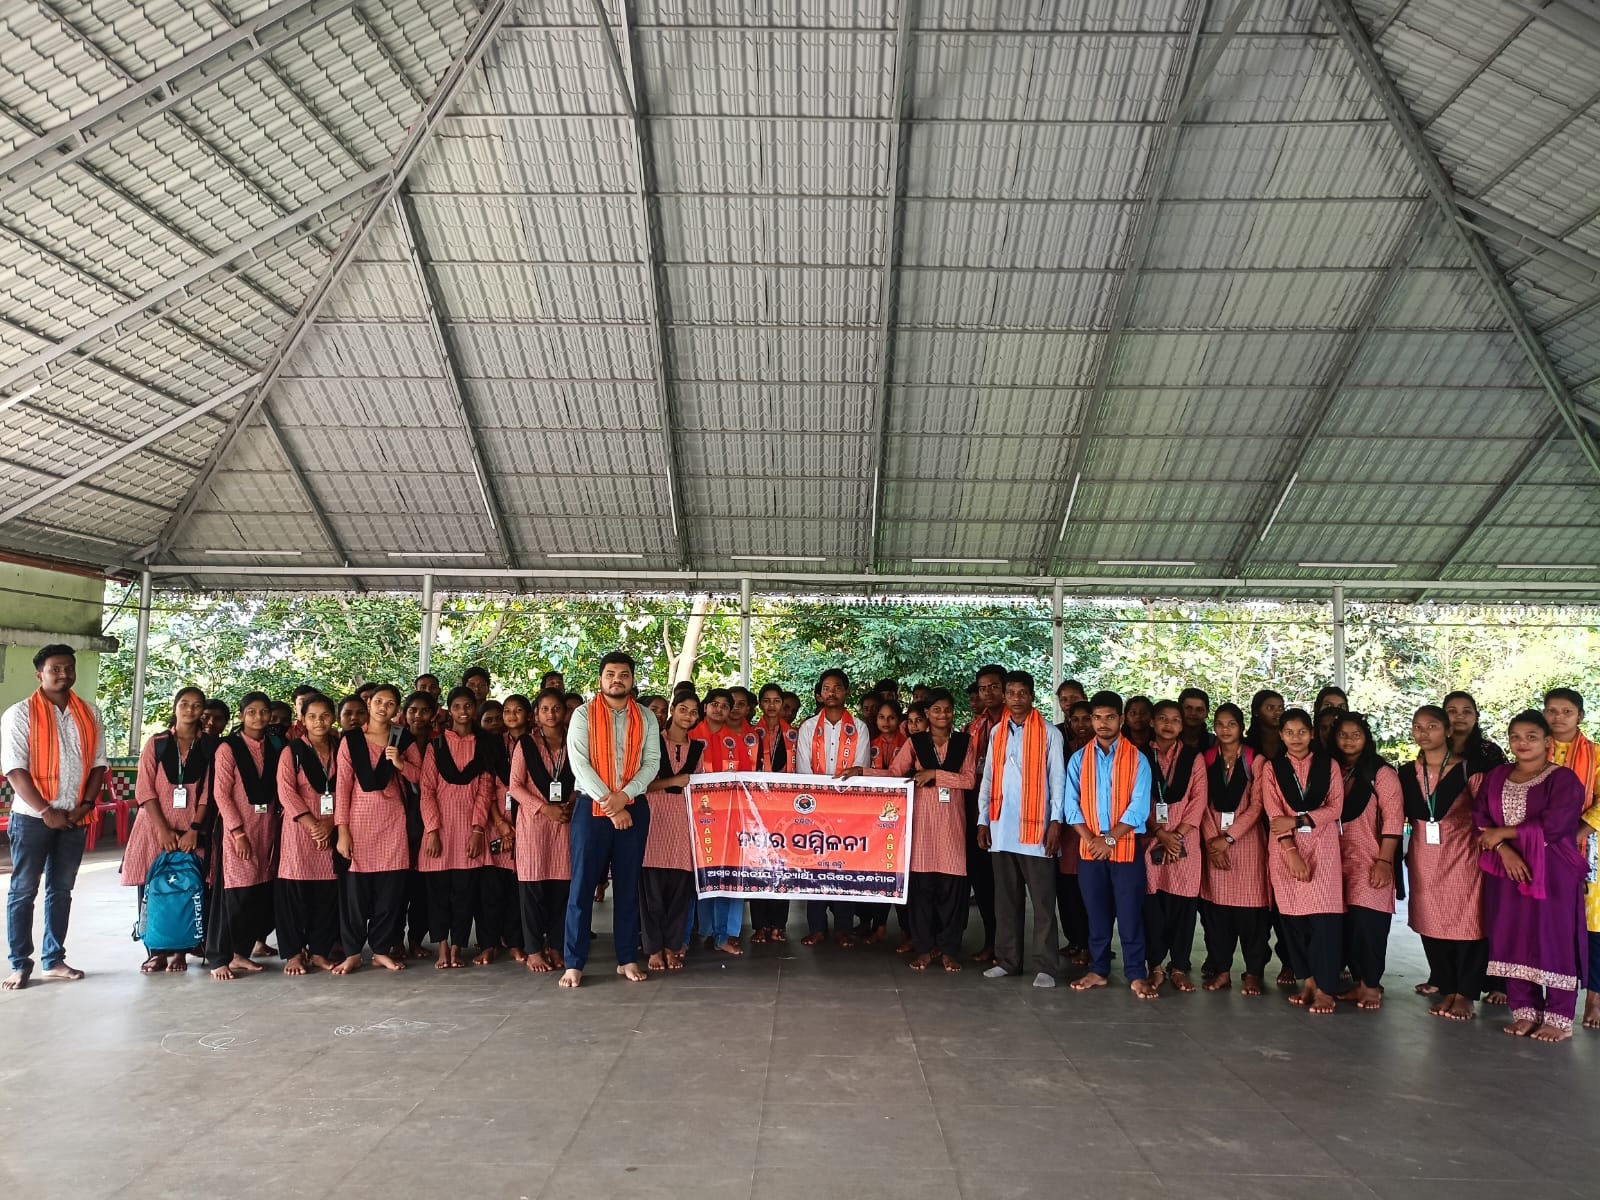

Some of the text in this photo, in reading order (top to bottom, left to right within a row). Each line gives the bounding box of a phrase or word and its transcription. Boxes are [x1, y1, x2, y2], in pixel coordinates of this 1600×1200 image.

[703, 827, 713, 864] ABVP
[886, 833, 895, 870] ABVP
[191, 892, 203, 939] fastrack
